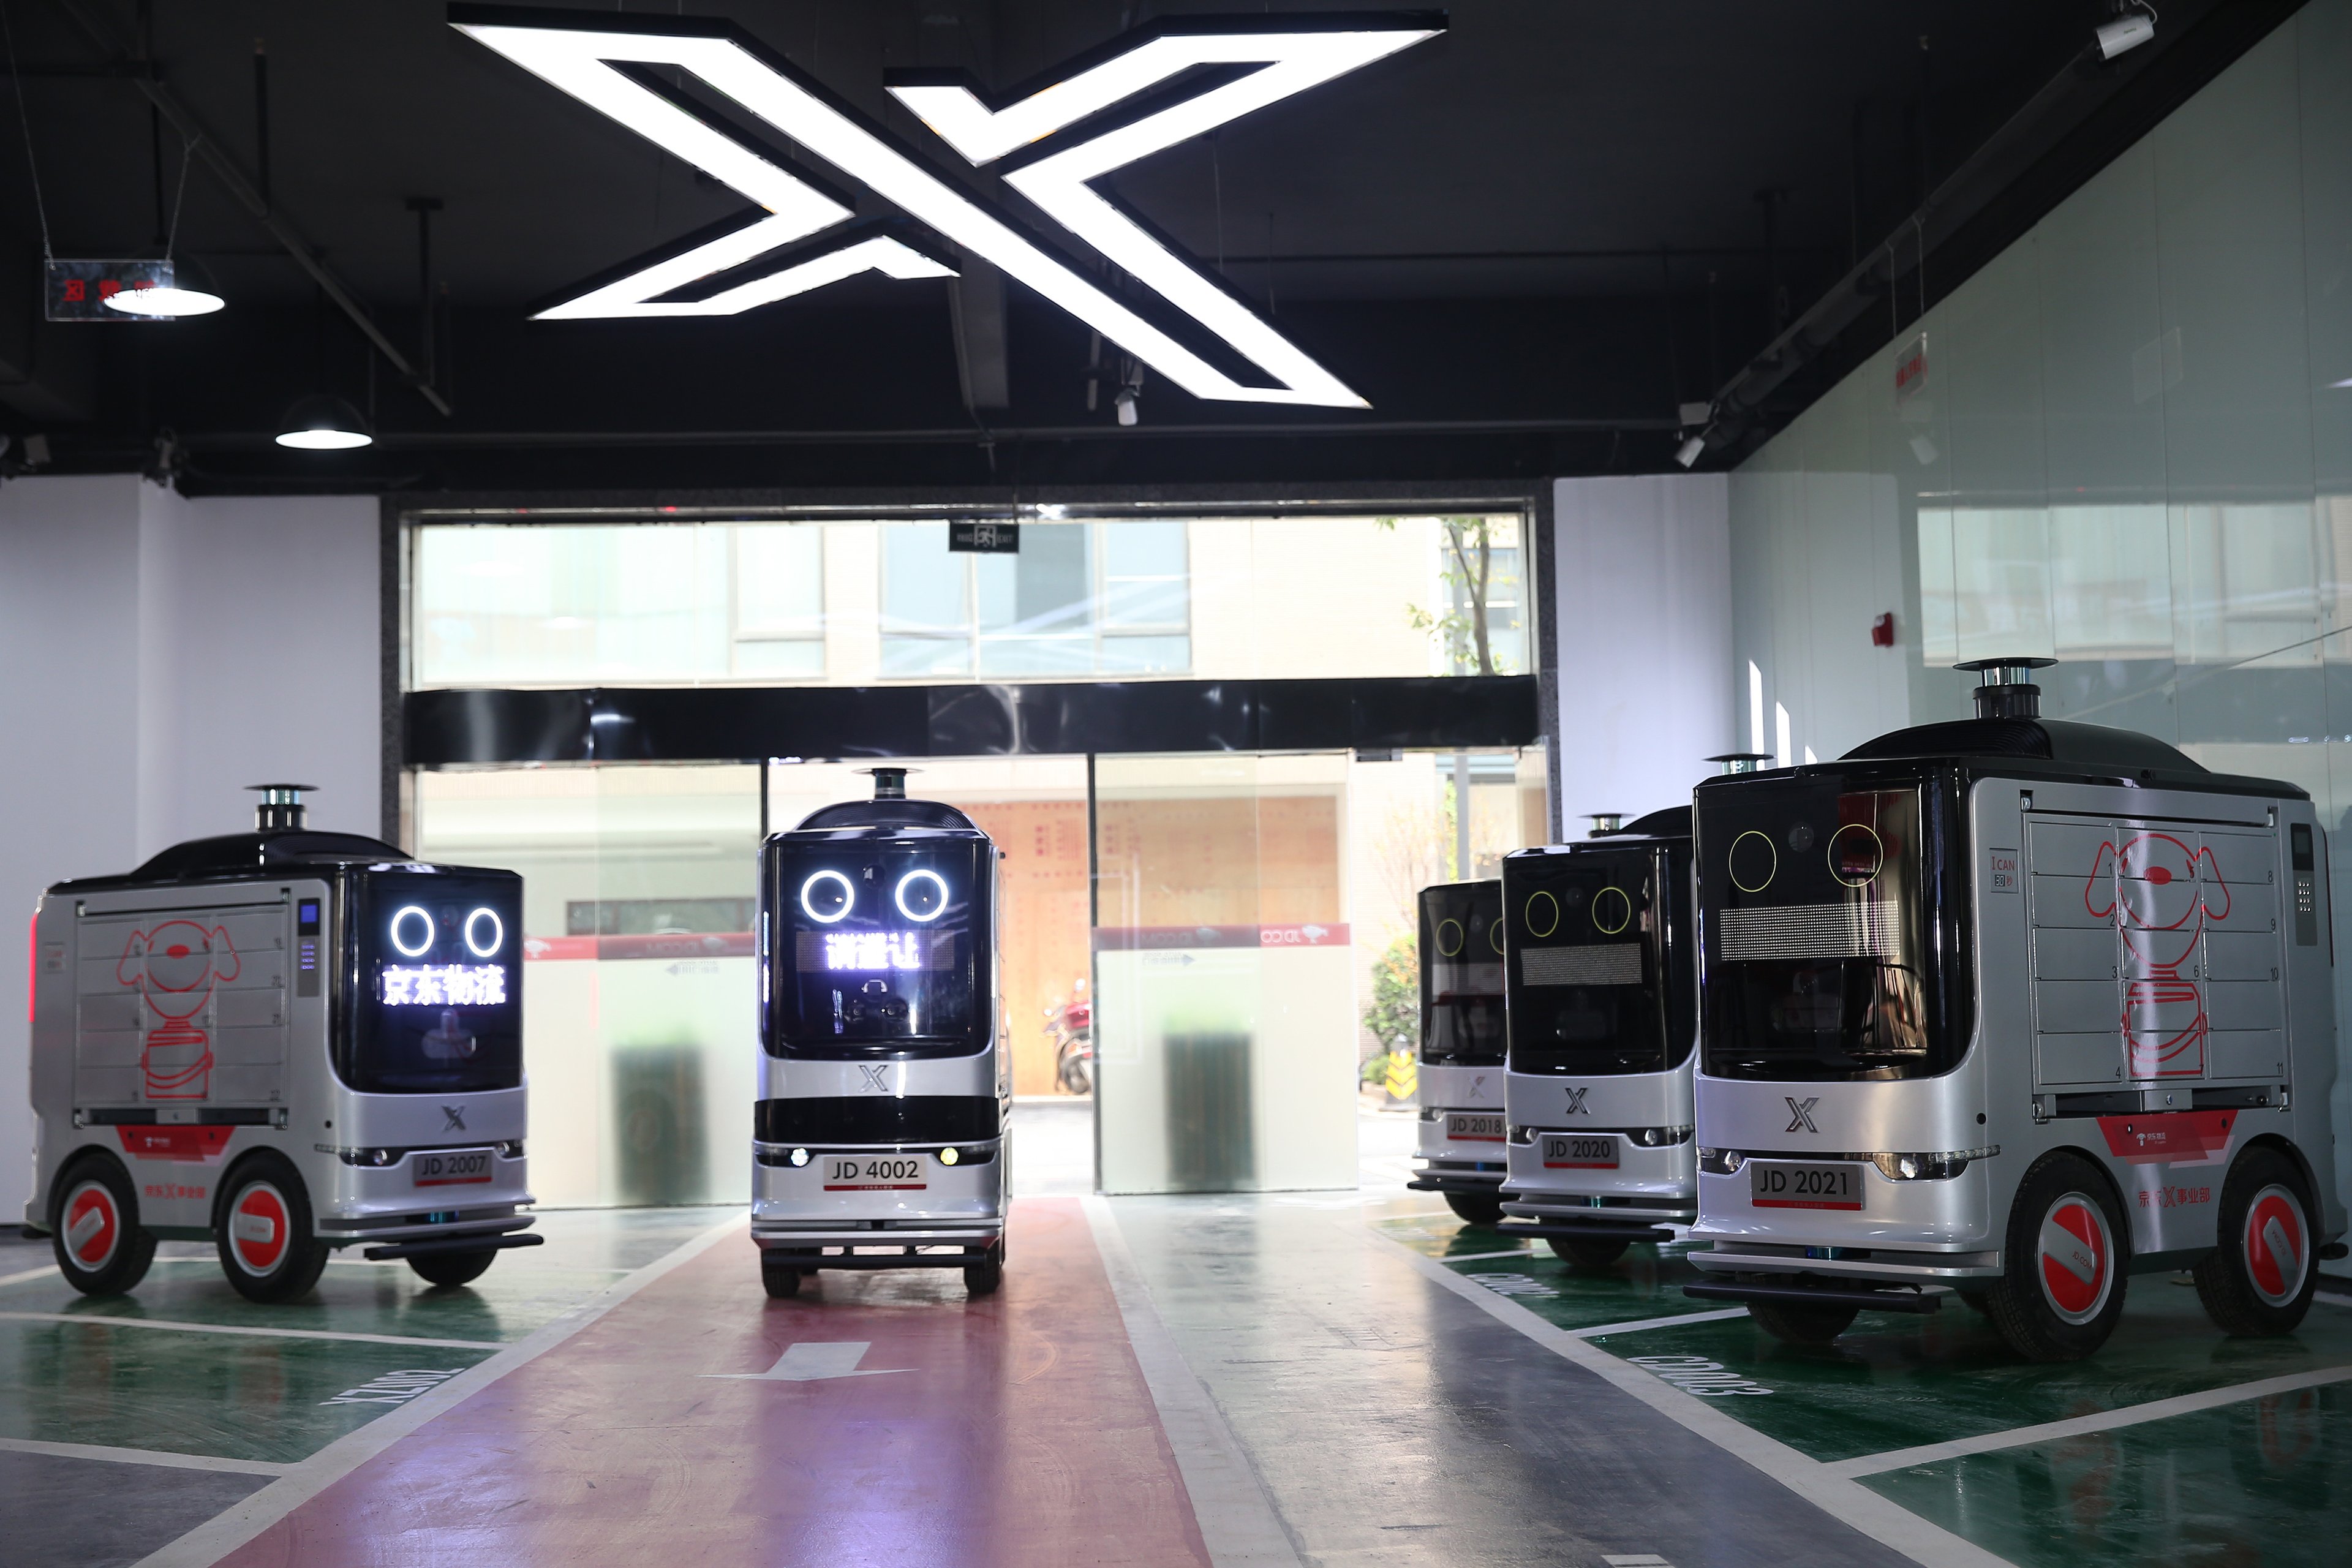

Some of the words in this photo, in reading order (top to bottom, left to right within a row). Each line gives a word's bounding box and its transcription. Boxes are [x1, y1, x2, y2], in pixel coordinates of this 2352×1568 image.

[1991, 856, 1996, 870] I
[1997, 859, 2015, 871] CAN
[2108, 862, 2113, 875] 1
[2268, 870, 2273, 883] 8
[2109, 914, 2116, 927] 2
[2271, 919, 2276, 930] 9
[2112, 966, 2118, 979] 3
[2194, 965, 2199, 978] 6
[2270, 967, 2279, 981] 10
[382, 963, 507, 1006] 京东物流
[2115, 1066, 2121, 1079] 4
[2199, 1064, 2204, 1077] 7
[2277, 1063, 2284, 1075] 11
[858, 1065, 889, 1093] X
[1466, 1076, 1486, 1099] X
[1564, 1087, 1591, 1115] X
[440, 1105, 466, 1133] X
[1784, 1096, 1820, 1133] X
[1450, 1118, 1467, 1133] JD
[1471, 1118, 1502, 1134] 2018
[1548, 1140, 1567, 1158] JD
[1572, 1140, 1611, 1158] 2020
[421, 1157, 443, 1176] JD
[448, 1155, 486, 1174] 2007
[832, 1162, 858, 1180] JD
[865, 1161, 918, 1179] 4002
[1760, 1170, 1787, 1193] JD
[1794, 1170, 1847, 1195] 2021
[1626, 1355, 1774, 1396] CD003
